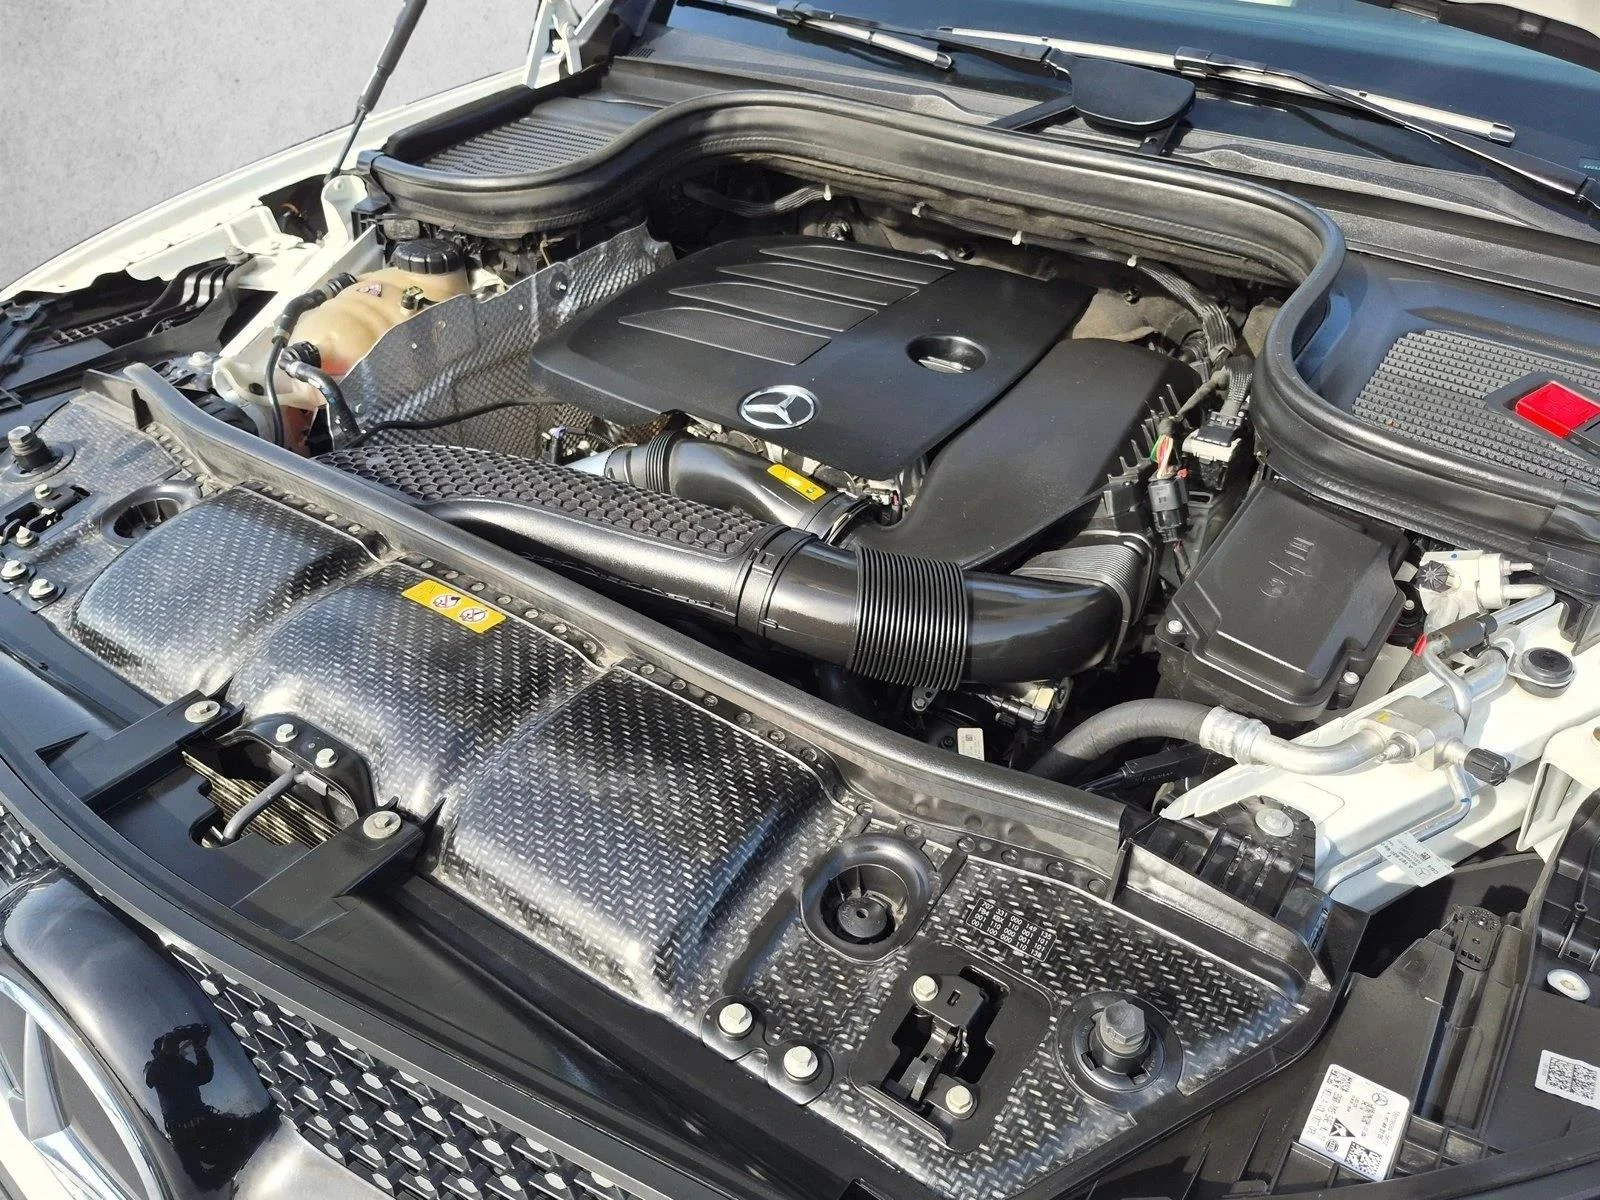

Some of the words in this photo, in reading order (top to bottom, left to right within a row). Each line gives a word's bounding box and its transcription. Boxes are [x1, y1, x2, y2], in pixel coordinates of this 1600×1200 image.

[971, 919, 983, 928] 001
[986, 926, 998, 936] 100
[1000, 933, 1013, 943] 000
[1016, 941, 1028, 951] 110
[974, 913, 987, 922] 001
[990, 920, 1001, 930] 110
[1003, 927, 1016, 937] 000
[1018, 935, 1031, 944] 001
[1033, 942, 1045, 952] 101
[981, 901, 994, 910] 707
[995, 908, 1008, 918] 331
[1010, 915, 1023, 925] 000
[1025, 923, 1038, 932] 149
[1040, 930, 1052, 940] 135
[1007, 921, 1020, 931] 110
[1021, 929, 1034, 938] 001
[1037, 936, 1049, 946] 101
